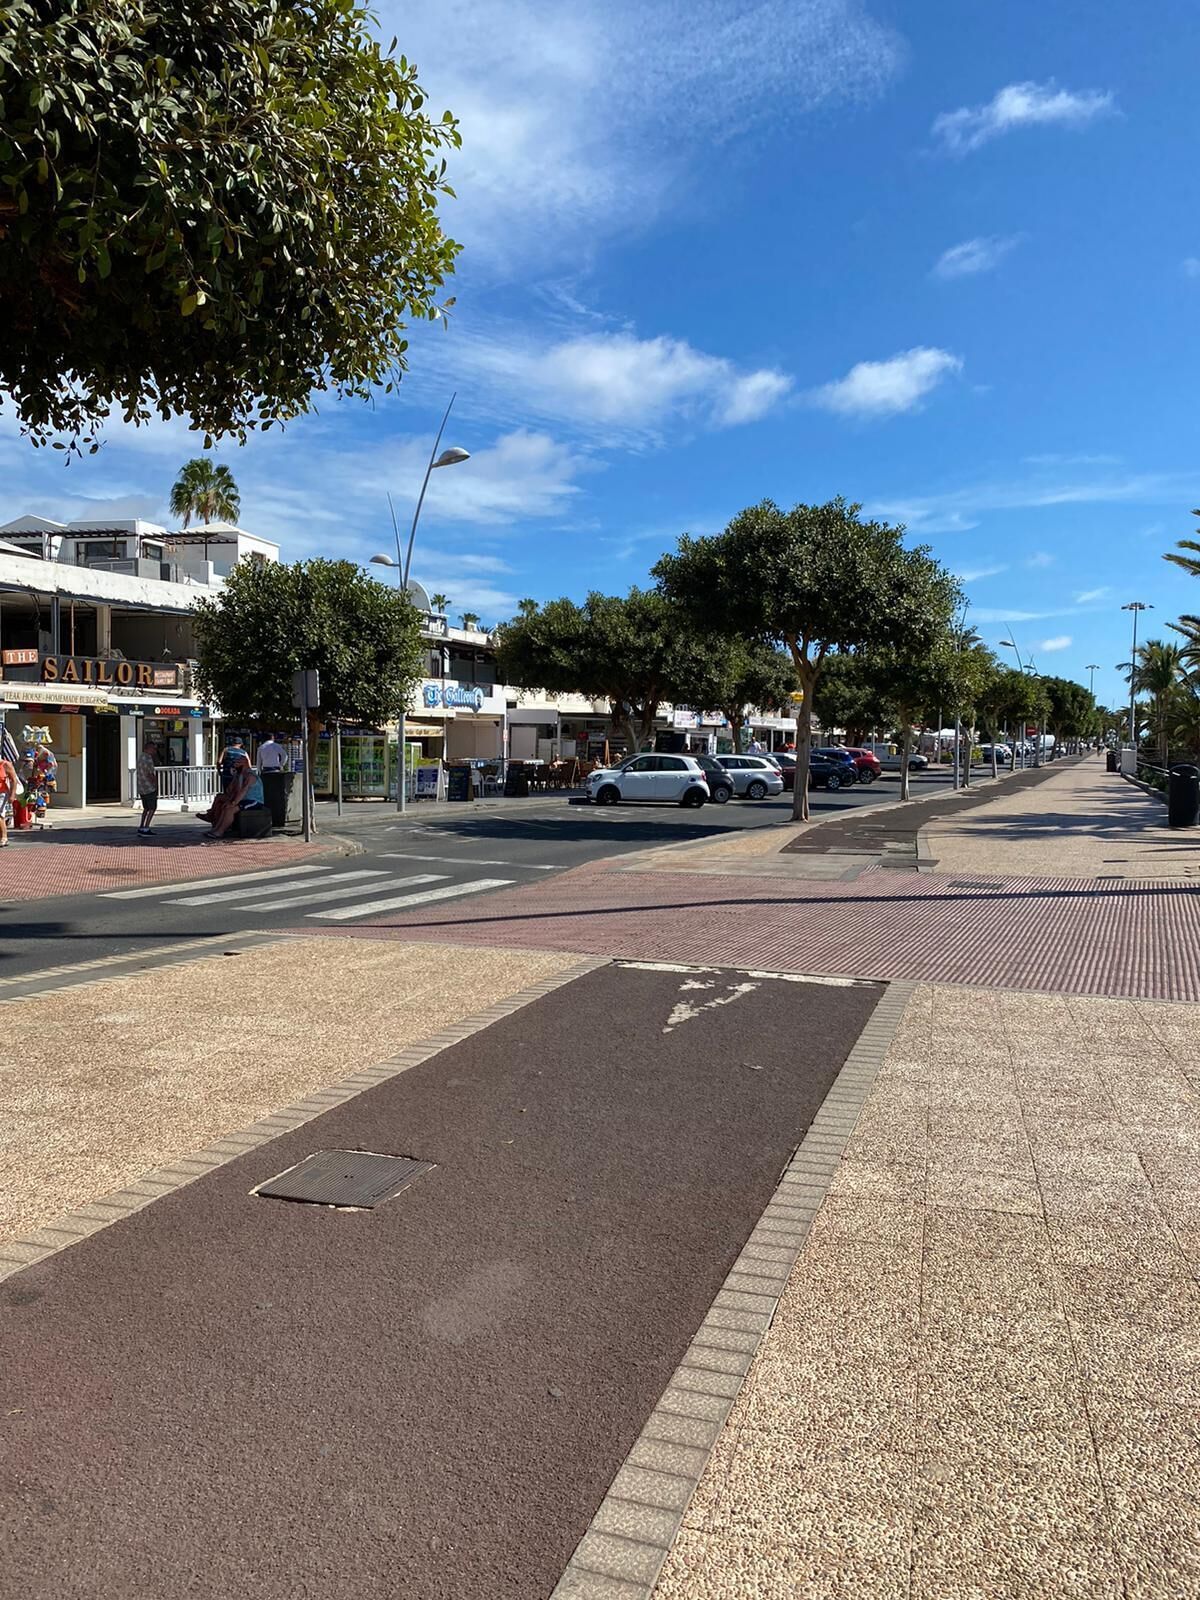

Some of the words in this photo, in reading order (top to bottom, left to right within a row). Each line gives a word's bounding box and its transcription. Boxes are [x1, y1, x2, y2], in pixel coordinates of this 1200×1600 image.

[7, 652, 36, 663] THE
[44, 657, 153, 685] SAILOR
[22, 692, 41, 702] HOUSE
[45, 694, 78, 702] HOMEMADE
